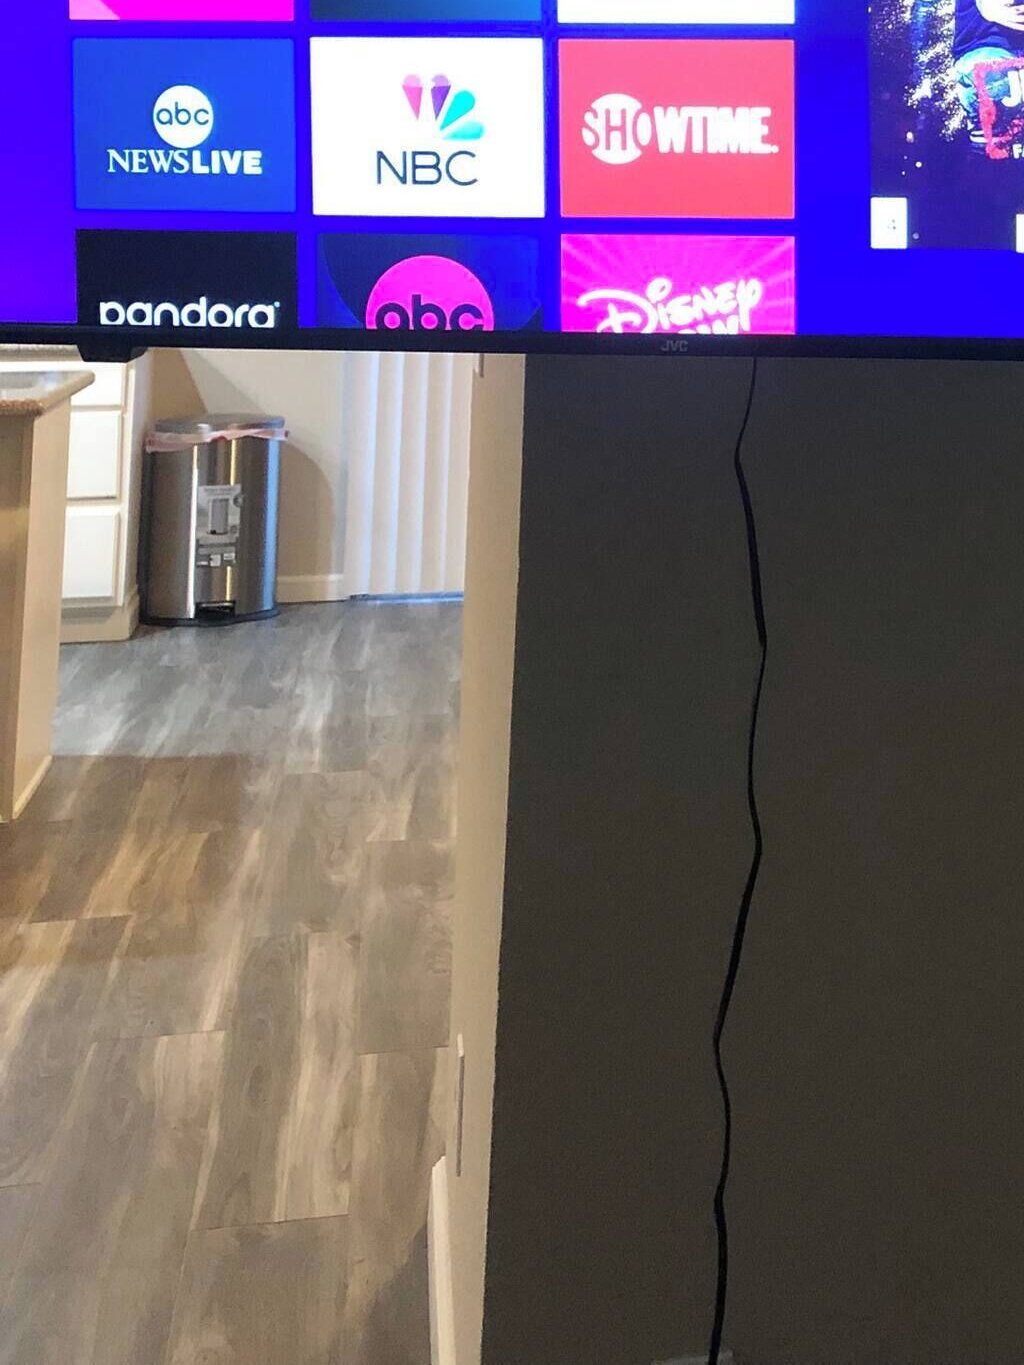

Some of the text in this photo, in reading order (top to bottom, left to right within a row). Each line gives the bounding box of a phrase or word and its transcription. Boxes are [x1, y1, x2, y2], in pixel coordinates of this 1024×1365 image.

[156, 101, 210, 126] abc
[376, 150, 479, 186] NBC
[99, 295, 276, 329] pandora
[375, 294, 485, 331] abc
[661, 339, 689, 352] JVC
